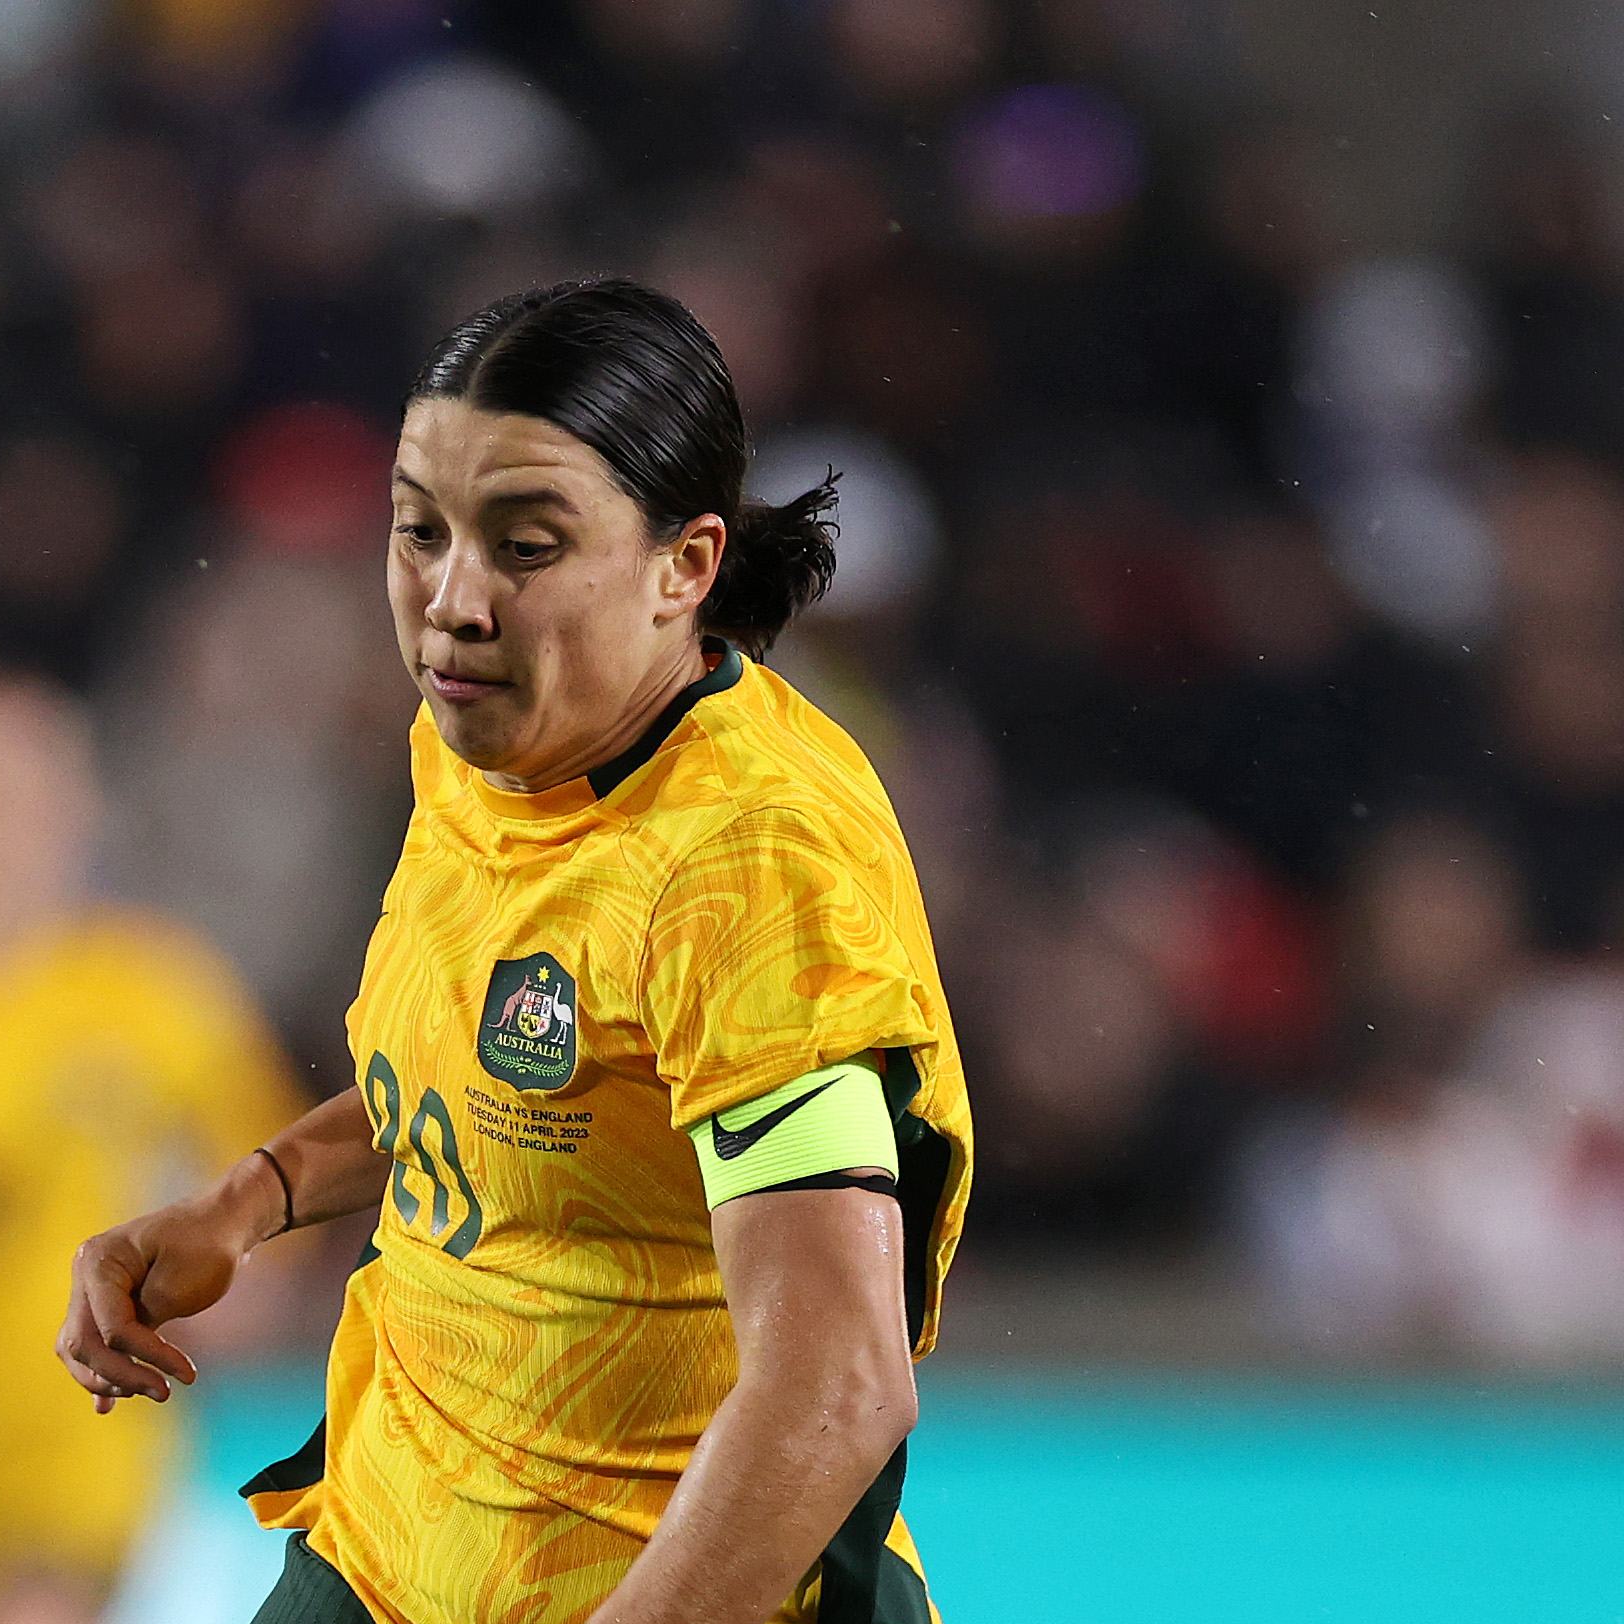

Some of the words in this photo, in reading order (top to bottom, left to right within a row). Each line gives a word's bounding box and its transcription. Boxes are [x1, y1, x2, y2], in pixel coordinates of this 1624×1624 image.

[495, 1033, 563, 1059] AUSTRALIA
[464, 1085, 512, 1115] AUSTRALIA
[513, 1107, 529, 1119] VS
[531, 1110, 593, 1123] ENGLAND
[467, 1102, 507, 1128] TUESDAY
[509, 1121, 519, 1132] 11
[523, 1124, 558, 1138] APRIL
[559, 1128, 589, 1139] 2023
[366, 1050, 483, 1260] 20
[473, 1121, 515, 1147] LONDON,
[518, 1138, 577, 1153] ENGLAND
